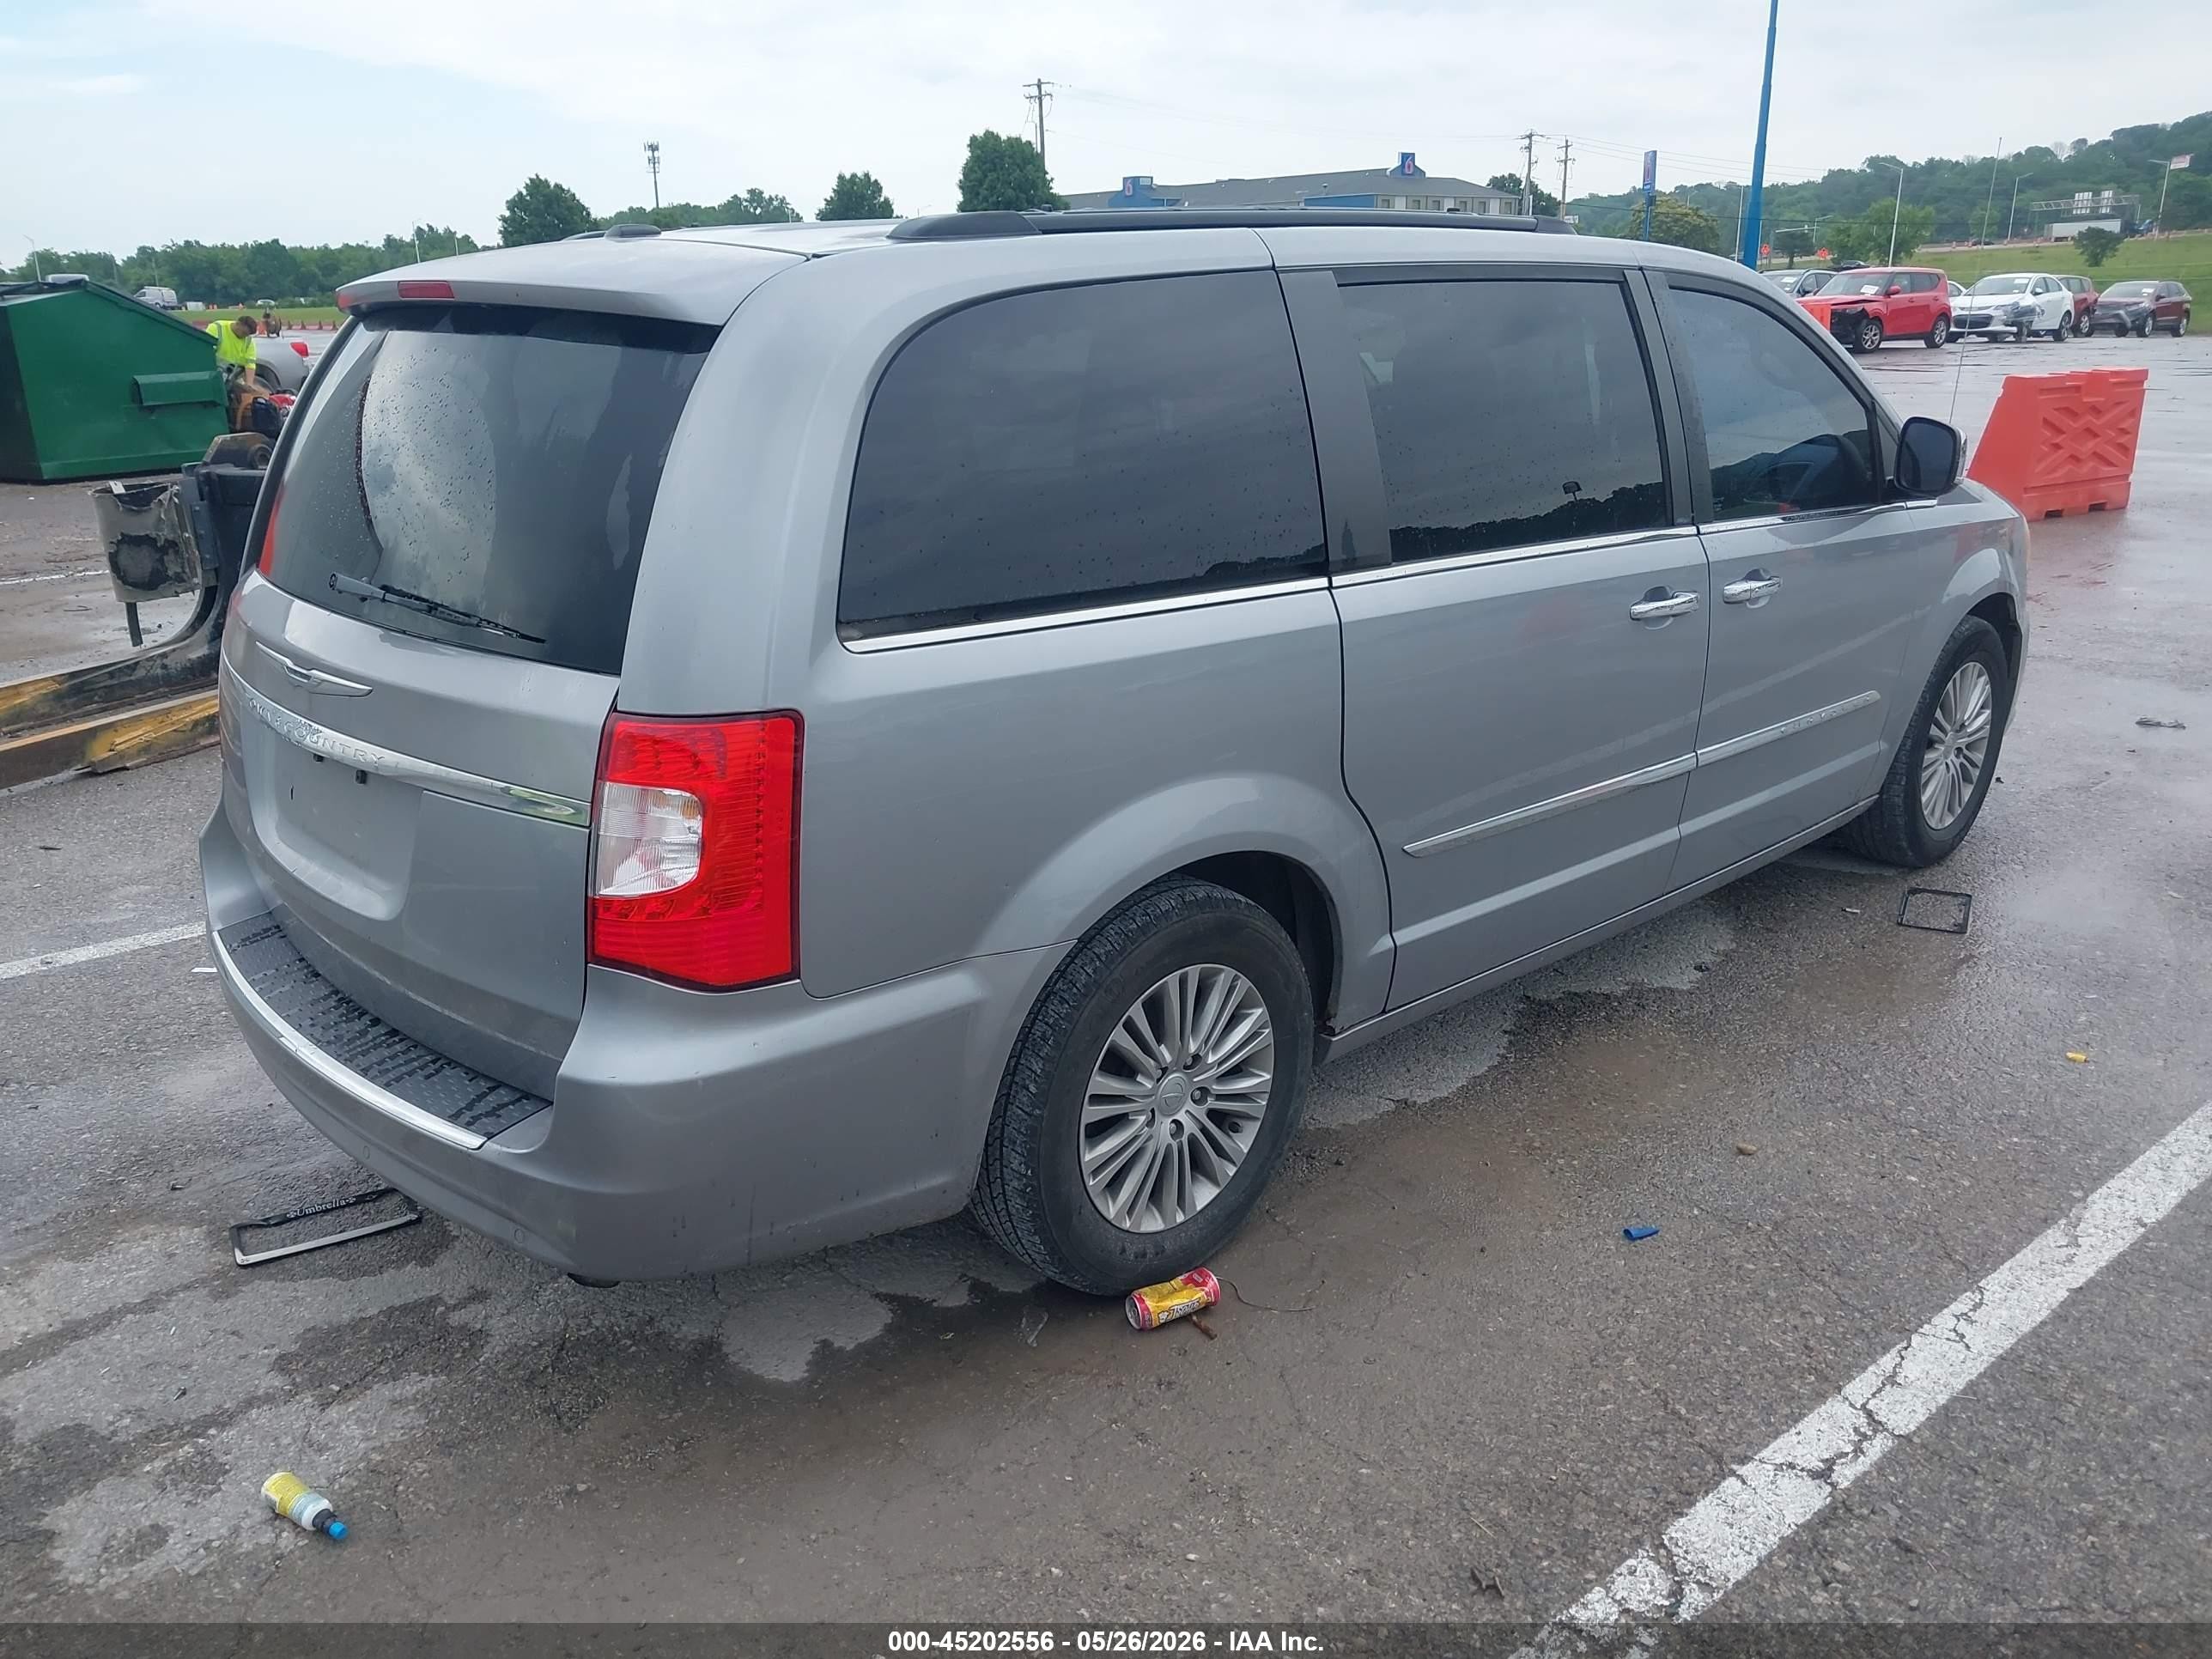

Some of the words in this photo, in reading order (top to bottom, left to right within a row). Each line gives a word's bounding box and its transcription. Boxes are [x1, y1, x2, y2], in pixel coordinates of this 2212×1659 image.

[1405, 155, 1414, 174] 6
[1125, 179, 1133, 196] 6
[283, 720, 385, 771] COUNTRY
